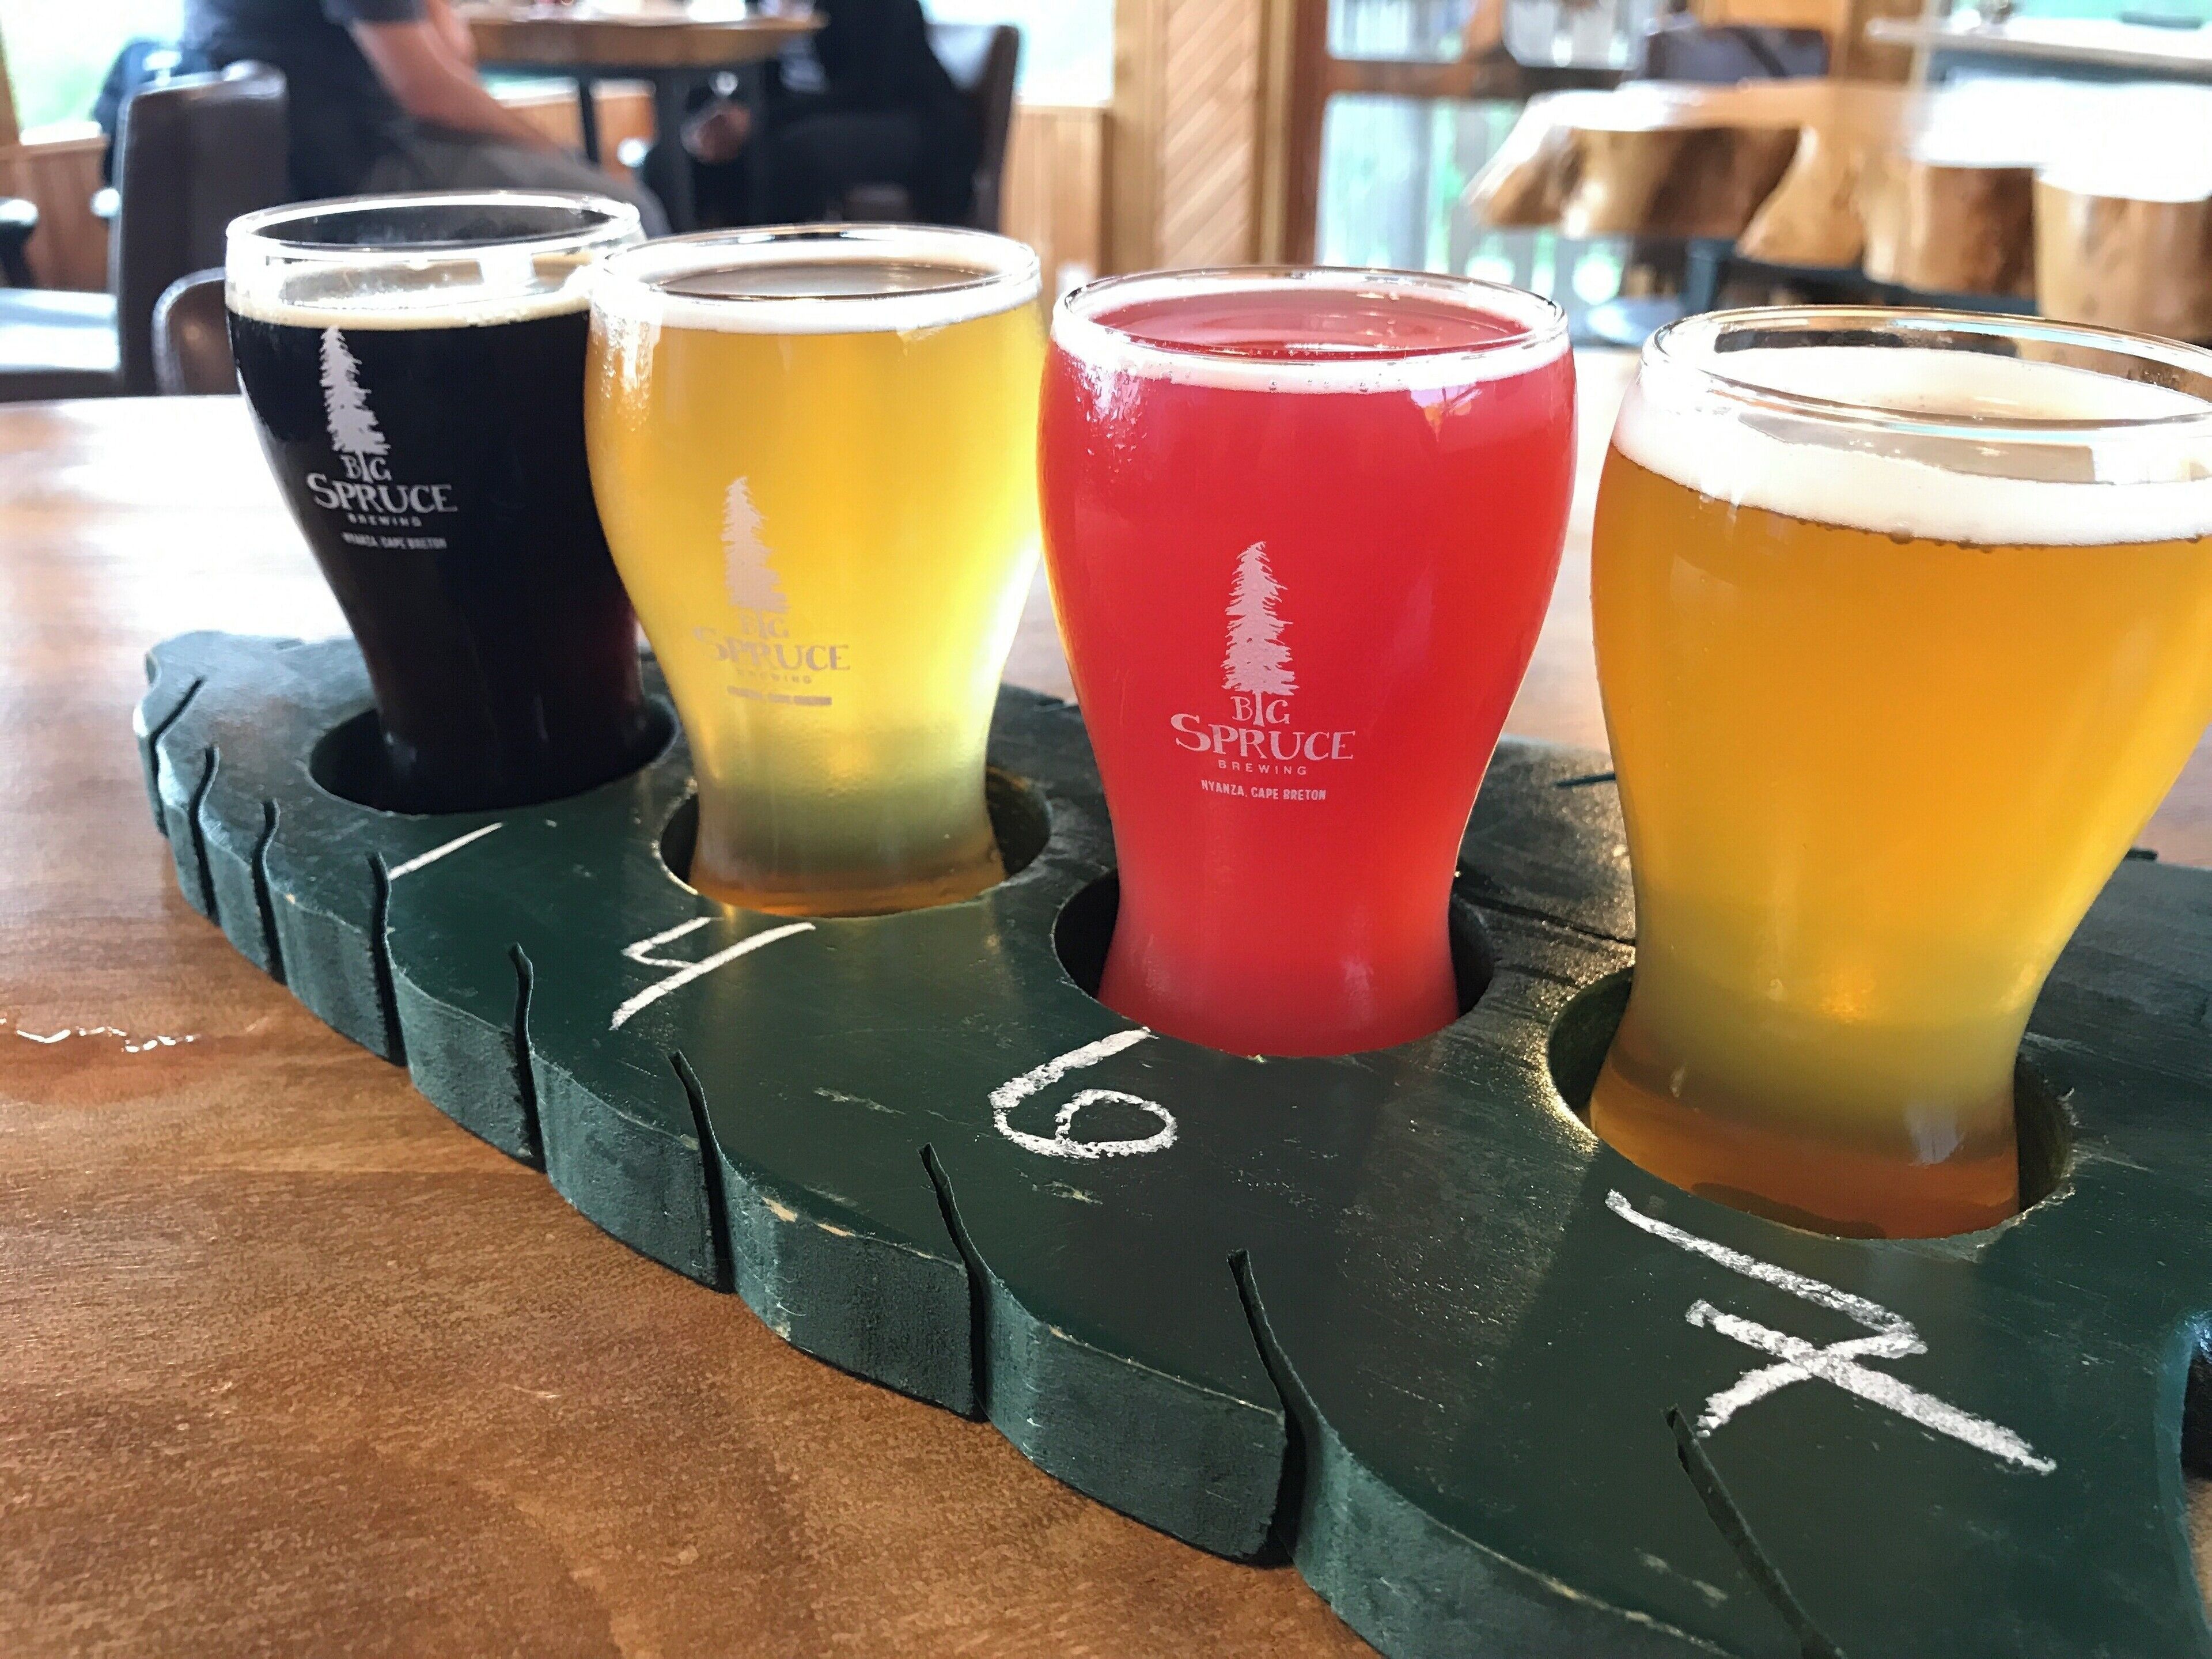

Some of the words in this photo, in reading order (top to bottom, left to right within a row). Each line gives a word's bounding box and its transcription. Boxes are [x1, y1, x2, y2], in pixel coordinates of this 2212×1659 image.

[340, 453, 392, 483] BIG
[306, 472, 459, 514] SPRUCE
[1230, 695, 1290, 727] BIG
[1170, 713, 1356, 760] SPRUCE
[1218, 760, 1307, 775] BREWING
[1251, 786, 1279, 800] CAPE
[1283, 789, 1327, 801] BRETON
[609, 916, 816, 1031] 4
[987, 1025, 1179, 1160] 6
[1605, 1188, 2058, 1476] 7
